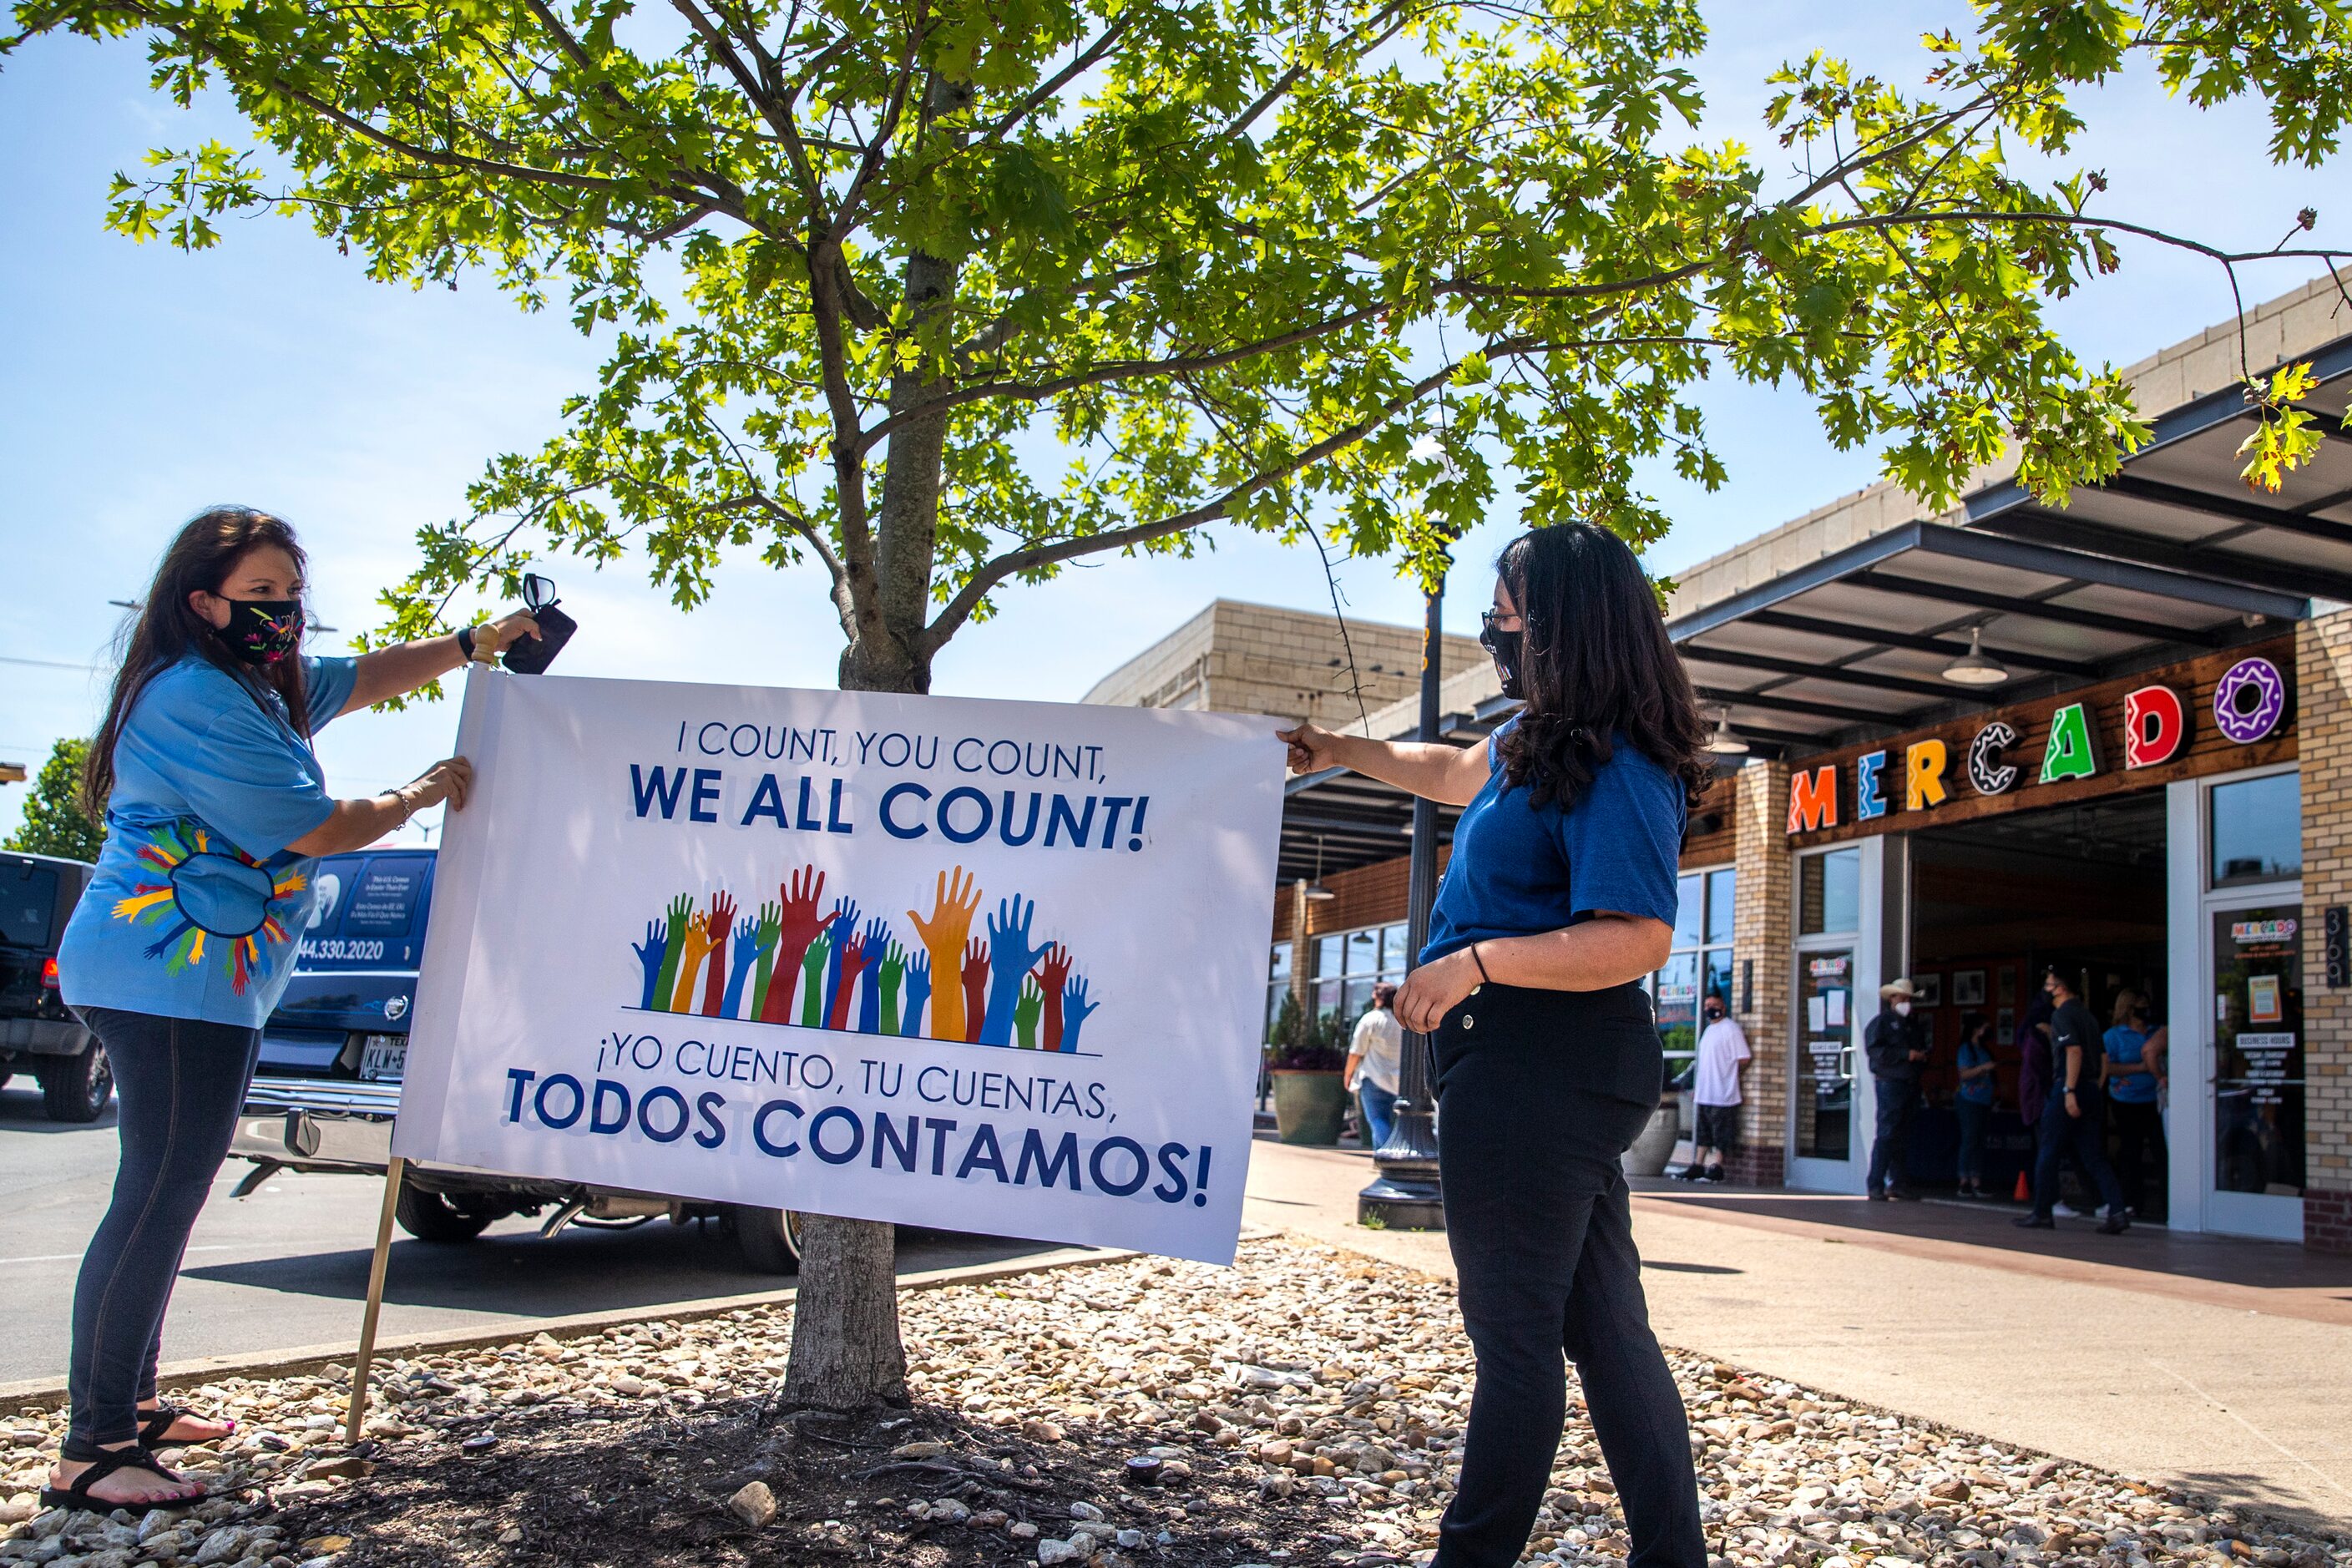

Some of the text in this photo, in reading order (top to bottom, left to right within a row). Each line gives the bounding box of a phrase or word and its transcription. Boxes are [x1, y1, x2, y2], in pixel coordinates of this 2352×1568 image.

[677, 721, 1106, 785] I COUNT, YOU COUNT,
[1786, 656, 2285, 835] MERCADO
[630, 763, 1151, 852] WE ALL COUNT!
[2233, 918, 2298, 936] MERCADO
[2326, 910, 2342, 985] 369
[597, 1032, 1117, 1124] ¡YO CUENTO, TU CUENTAS,
[507, 1068, 1212, 1208] TODOS CONTAMOS!
